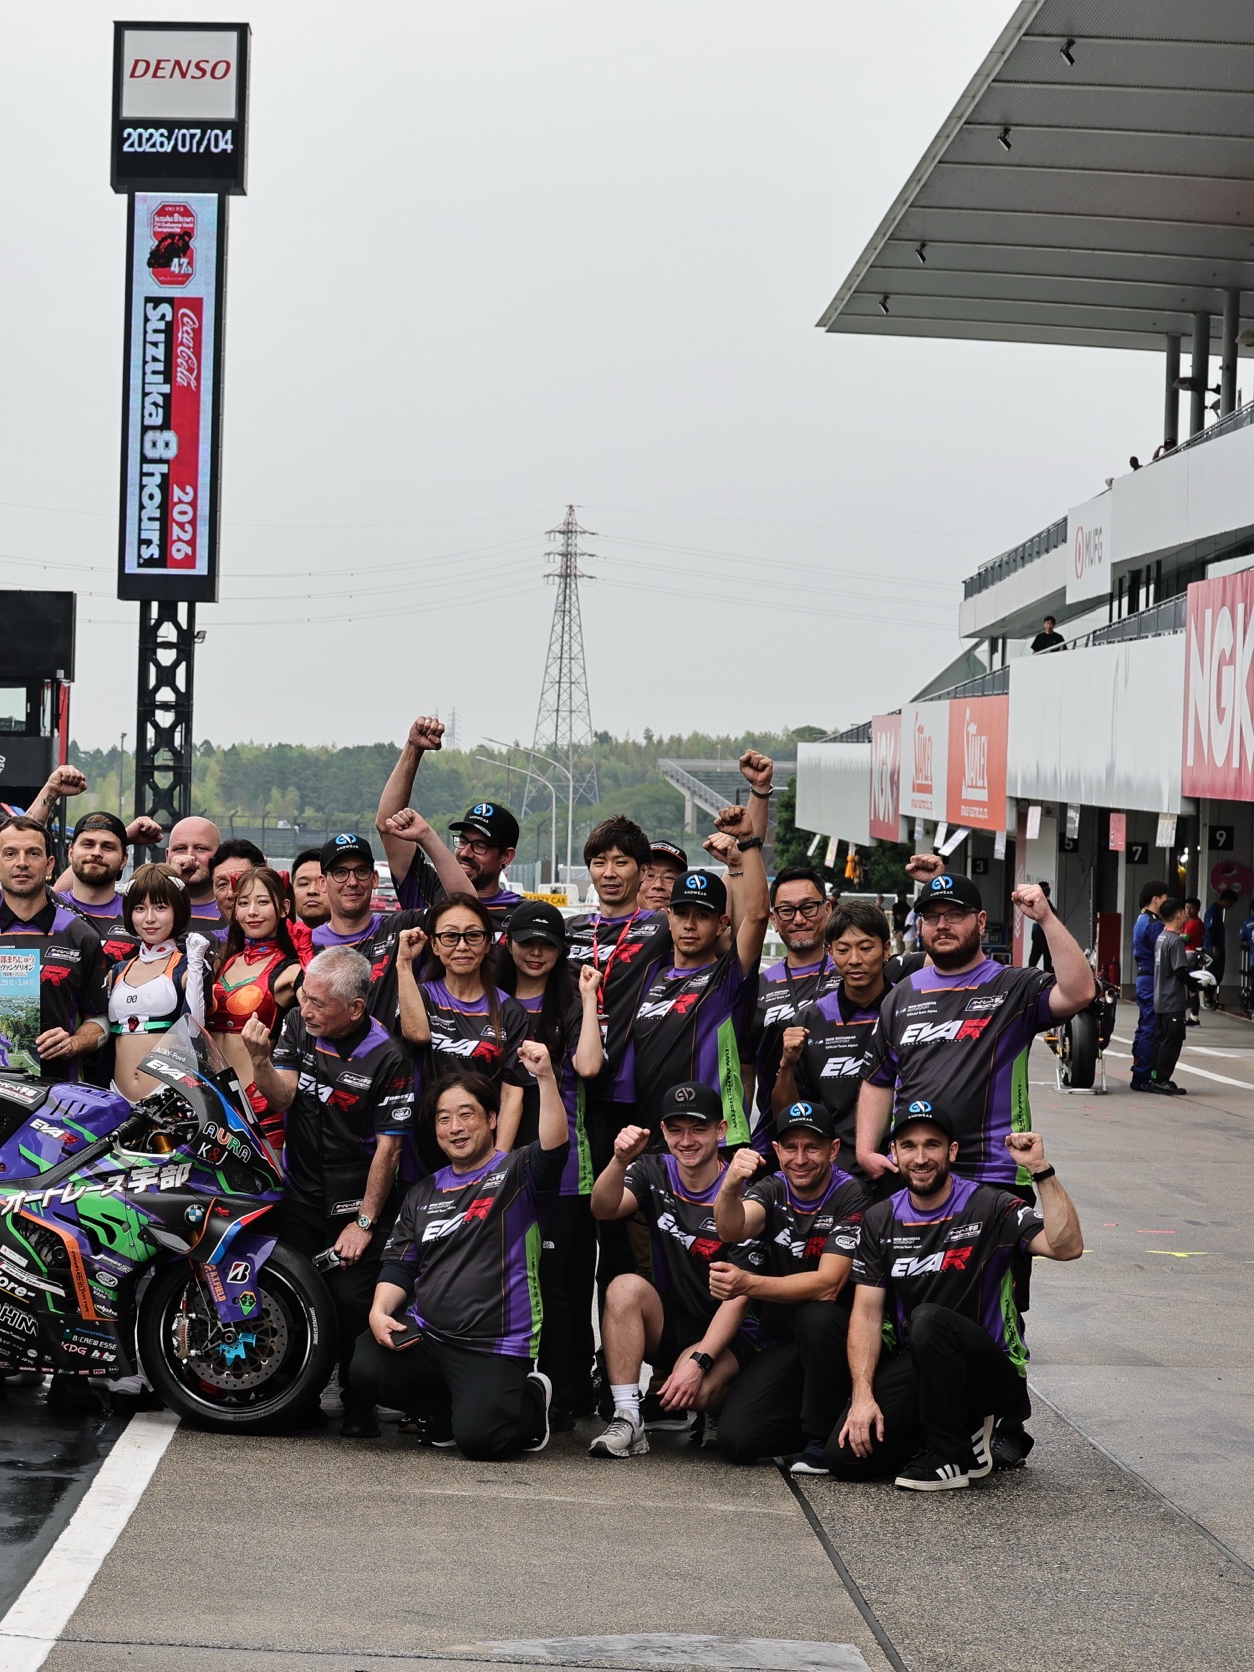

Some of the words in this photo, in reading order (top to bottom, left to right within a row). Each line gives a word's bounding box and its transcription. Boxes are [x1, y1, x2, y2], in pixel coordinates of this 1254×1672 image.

[129, 59, 231, 80] DENSO
[123, 128, 233, 153] 2026/07/04
[144, 302, 172, 426] Suzuka
[176, 308, 198, 390] Coca-Cola
[142, 430, 178, 460] 8
[140, 464, 168, 560] hours
[172, 485, 194, 560] 2026
[1085, 526, 1102, 568] MUFG
[1187, 603, 1254, 775] NGK
[961, 706, 988, 801] STANLEY
[870, 731, 895, 824] NGK
[1064, 838, 1073, 849] 5
[1216, 831, 1226, 845] 9
[976, 861, 984, 872] 3
[1132, 846, 1142, 861] 7
[551, 897, 566, 905] CAR
[197, 1142, 228, 1165] K&J
[203, 1122, 251, 1163] AURA
[1, 1162, 193, 1216] オートレース宇部
[209, 1271, 226, 1302] A.T.FIELD
[97, 1304, 118, 1316] alpha
[309, 1307, 318, 1345] BRIDGESTONE
[91, 1350, 116, 1362] hits
[99, 1341, 117, 1350] ESSE
